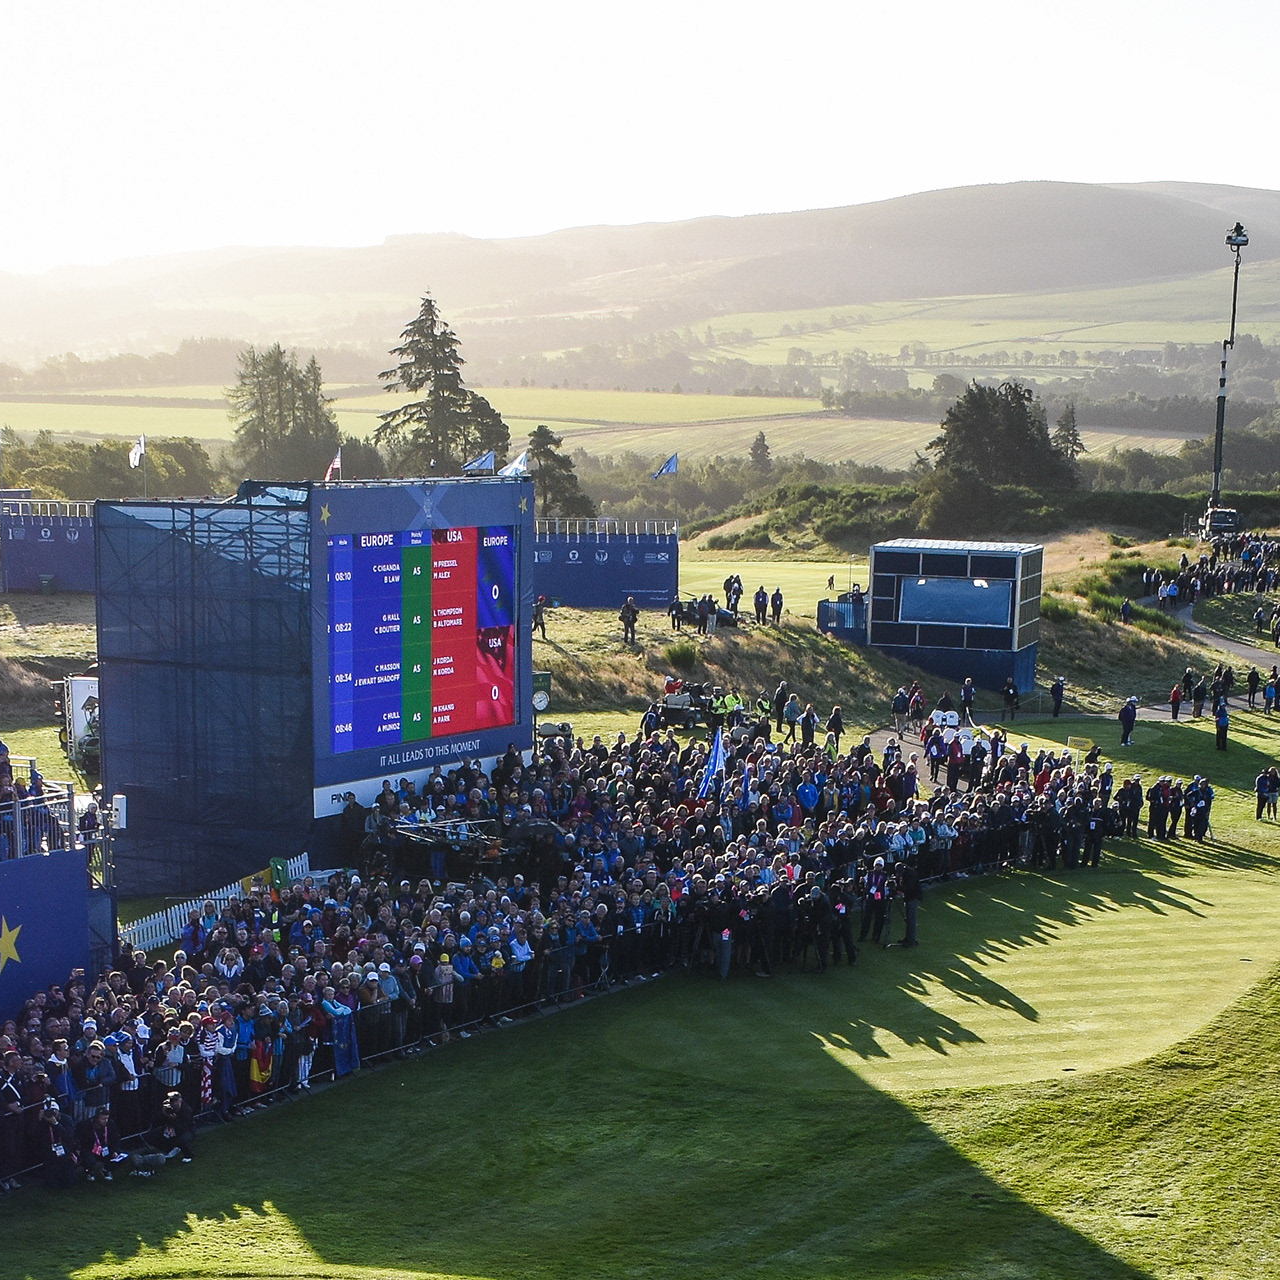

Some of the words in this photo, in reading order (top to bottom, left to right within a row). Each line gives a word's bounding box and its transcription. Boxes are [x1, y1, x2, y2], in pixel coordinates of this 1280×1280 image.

[361, 534, 394, 548] EUROPE
[446, 530, 462, 542] USA
[483, 536, 508, 547] EUROPE
[413, 566, 422, 576] AS
[335, 572, 352, 582] 08:10
[389, 575, 400, 583] LAW
[492, 584, 500, 600] 0
[413, 616, 422, 624] AS
[335, 622, 352, 633] 08:22
[488, 638, 502, 648] USA
[380, 662, 400, 671] MASSON
[413, 664, 421, 673] AS
[335, 673, 352, 683] 08:34
[492, 685, 499, 700] 0
[413, 712, 421, 722] AS
[438, 714, 451, 723] PARK
[335, 722, 352, 734] 08:46
[380, 754, 387, 767] IT
[388, 751, 401, 766] ALL
[402, 748, 424, 763] LEADS
[424, 746, 434, 758] TO
[435, 744, 450, 756] THIS
[450, 739, 481, 754] MOMENT
